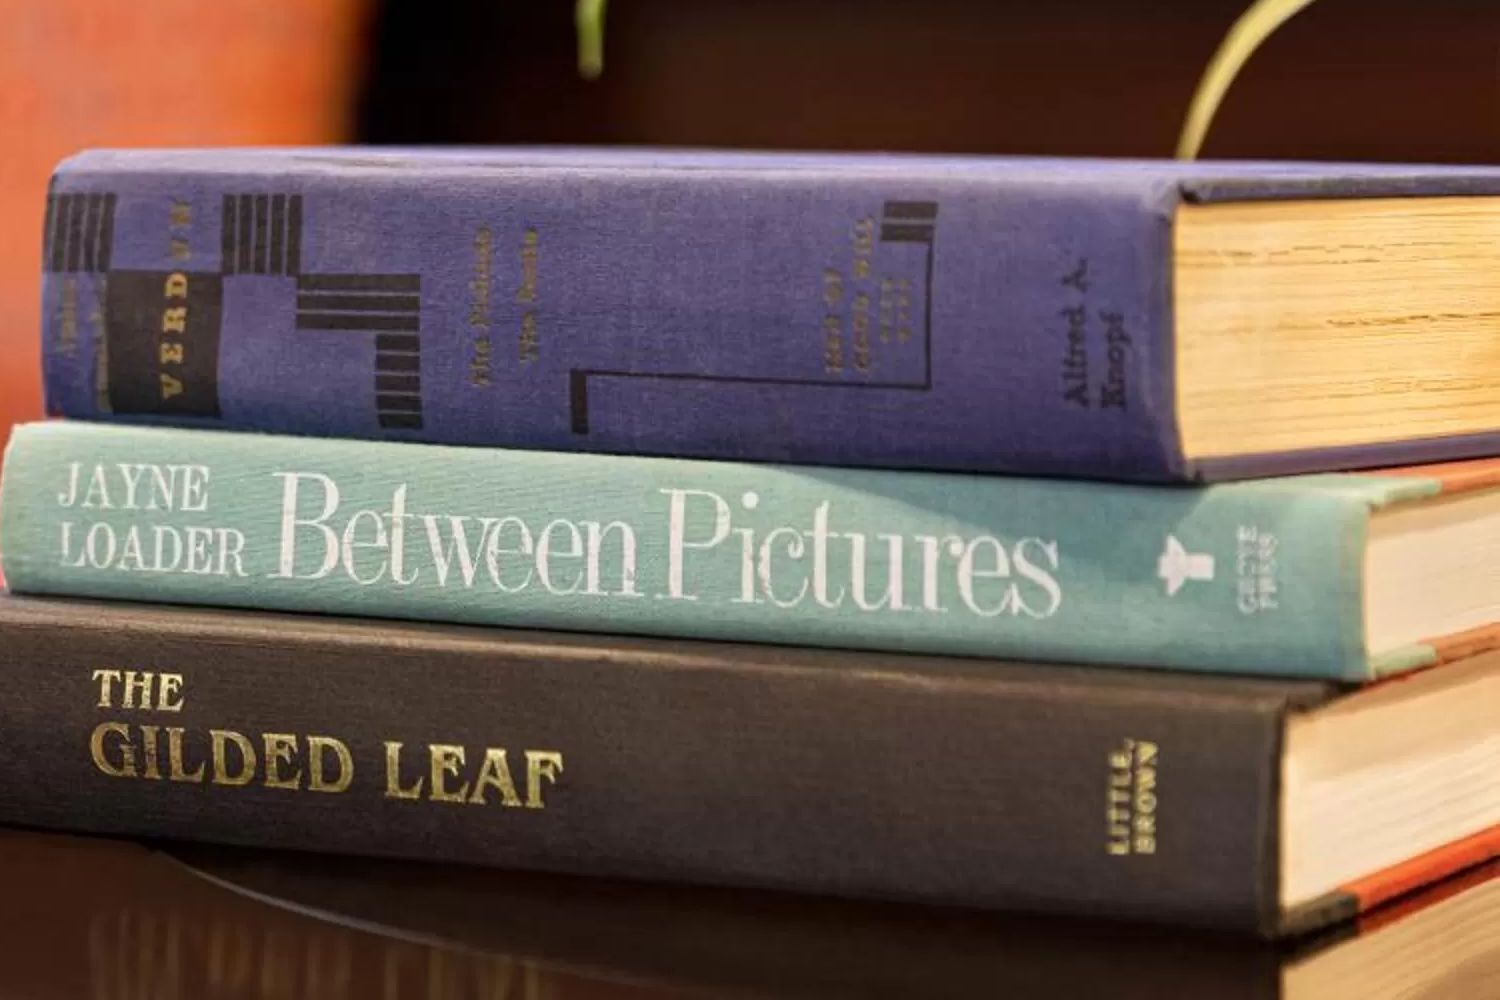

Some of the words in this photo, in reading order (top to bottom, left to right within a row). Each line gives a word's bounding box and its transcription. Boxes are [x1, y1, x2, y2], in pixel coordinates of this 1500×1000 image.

[158, 198, 194, 399] VERDUN
[1060, 304, 1090, 409] Alfred
[1099, 308, 1132, 410] Knopf
[57, 462, 211, 513] JAYNE
[59, 521, 249, 578] LOADER
[266, 471, 645, 598] Between
[654, 487, 1063, 620] Pictures
[91, 668, 186, 712] THE
[89, 721, 355, 794] GILDED
[383, 739, 565, 810] LEAF
[1133, 741, 1158, 855] BROWN
